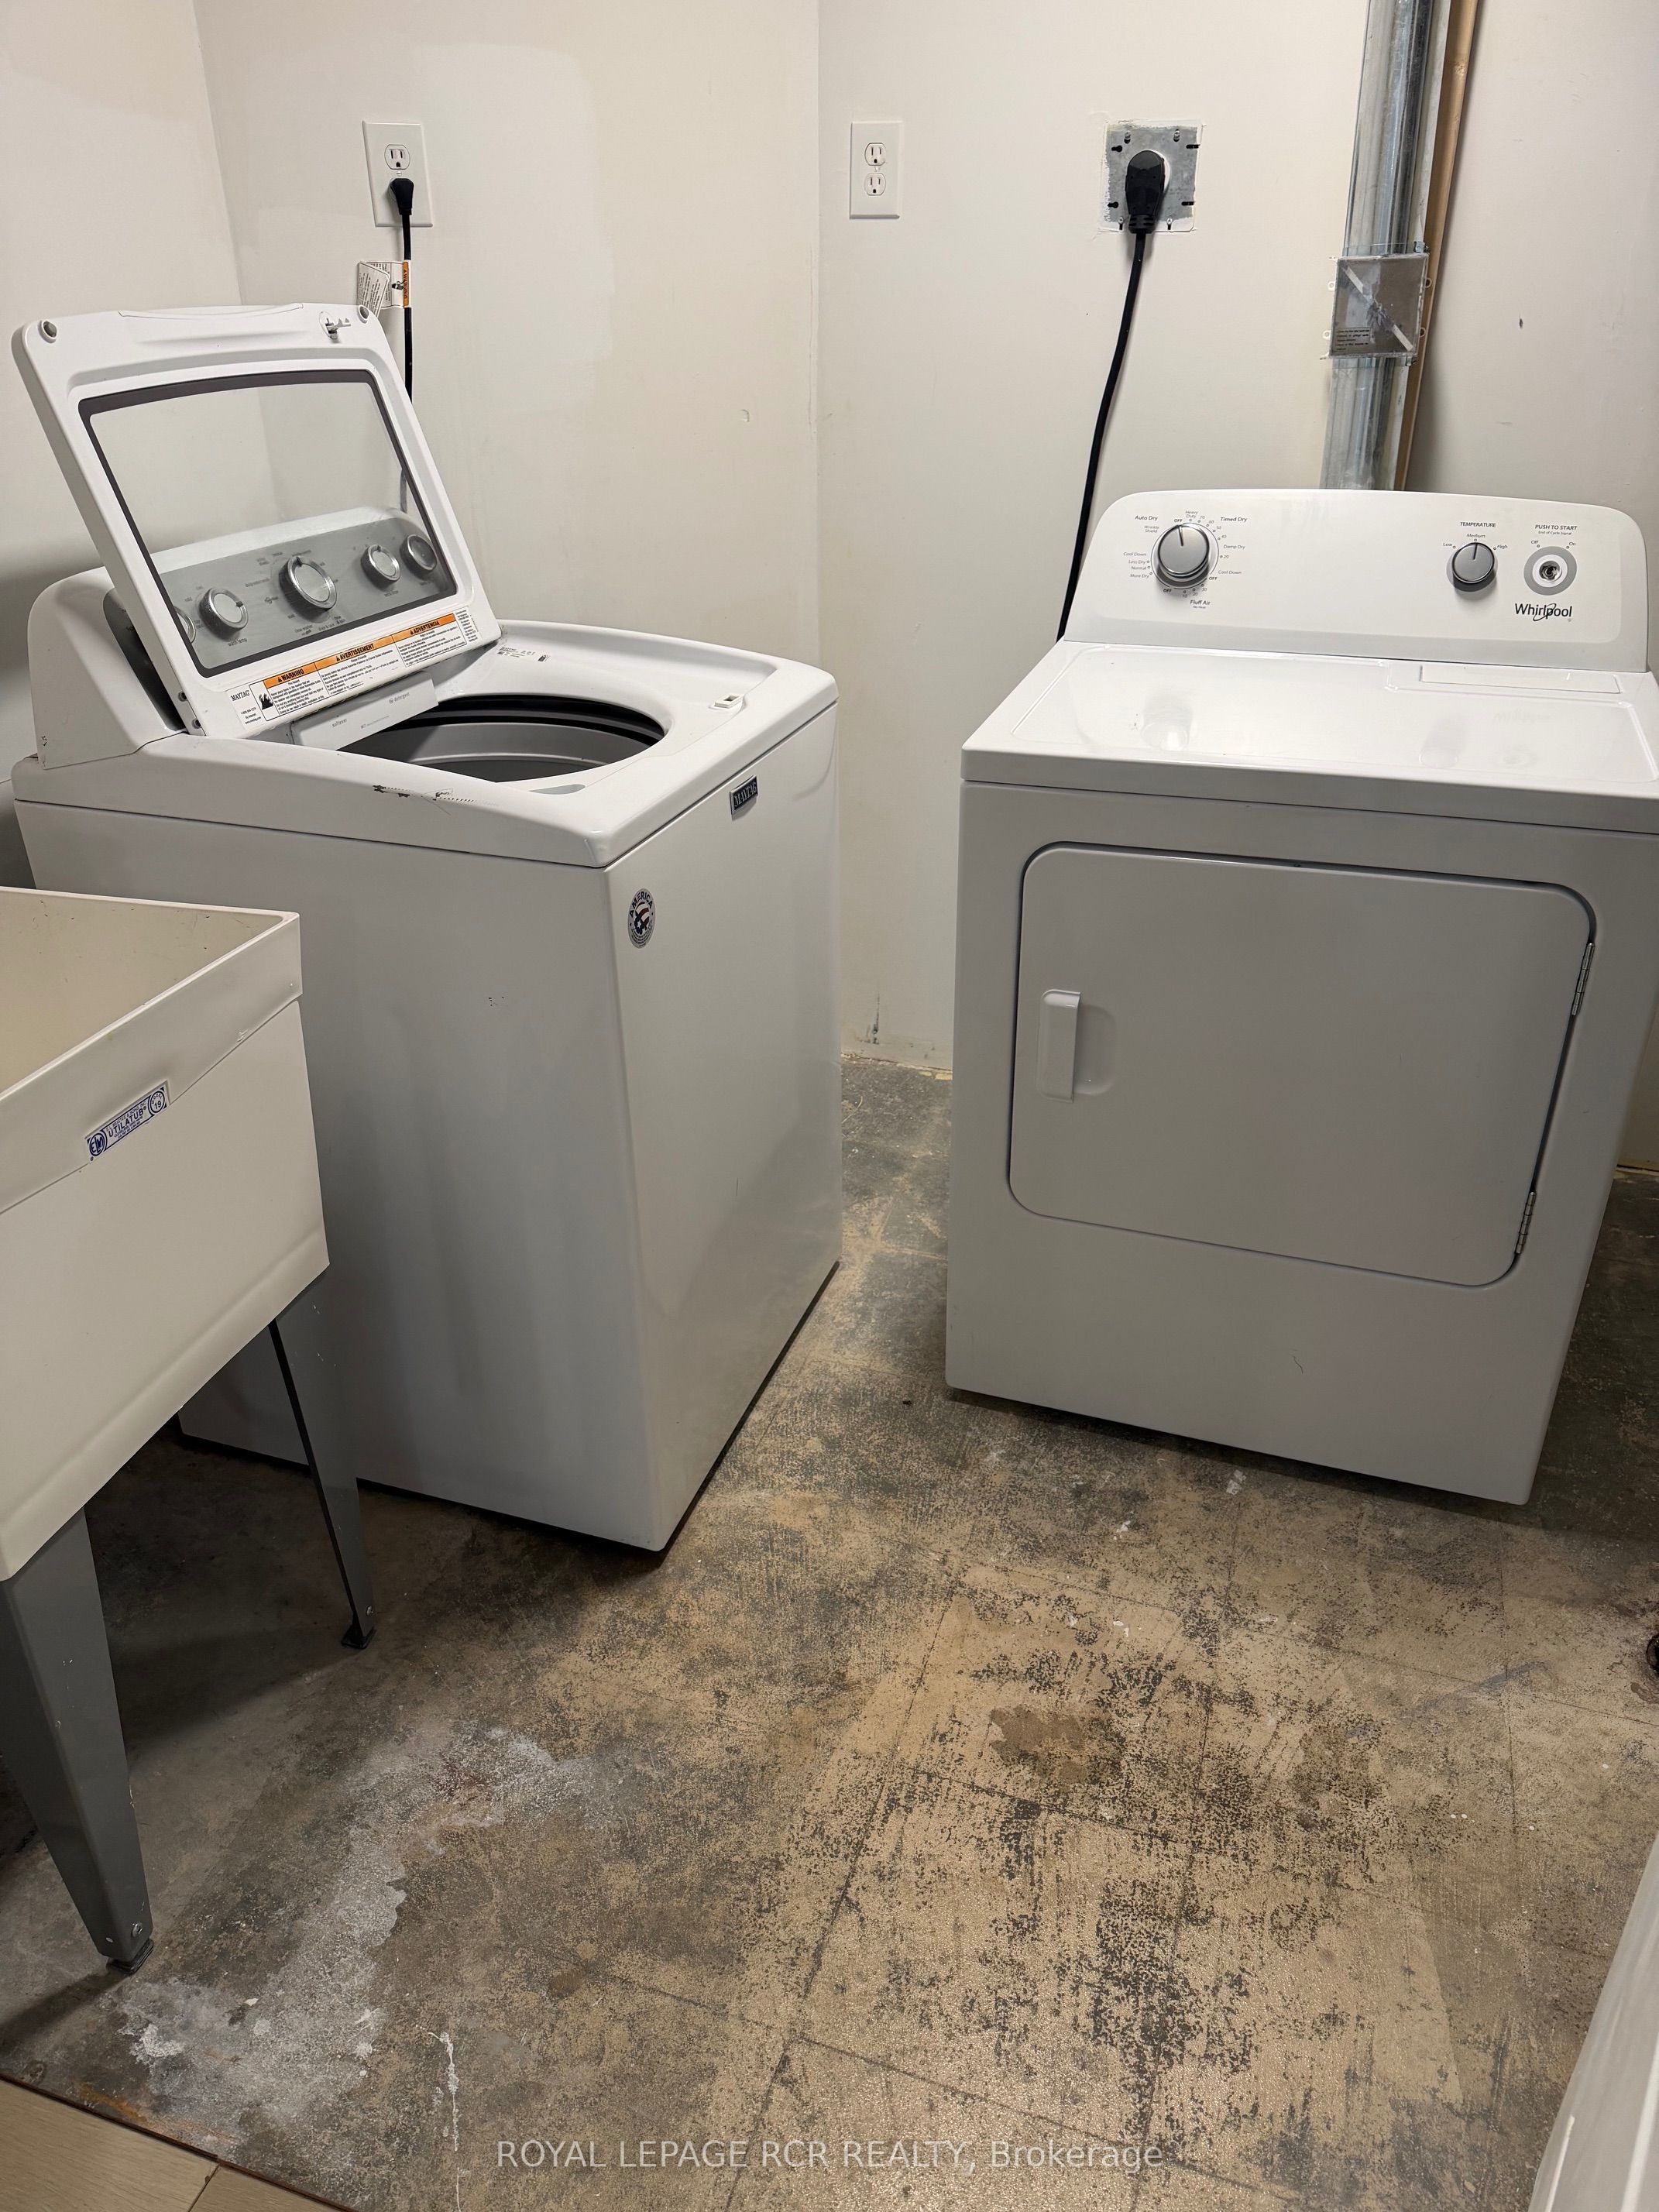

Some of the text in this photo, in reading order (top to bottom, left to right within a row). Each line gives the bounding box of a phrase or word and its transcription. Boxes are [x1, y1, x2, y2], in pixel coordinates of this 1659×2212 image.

[1514, 603, 1572, 621] Whirlpool
[413, 620, 440, 634] ADVERTENCIA
[339, 643, 375, 660] AVERTISSEMENT
[280, 668, 305, 681] WARNING
[230, 689, 250, 702] MAYTAG
[733, 781, 757, 807] MAYTAG
[629, 891, 653, 919] AMERICA
[154, 1100, 162, 1110] 19
[108, 1108, 143, 1137] UTILATUB
